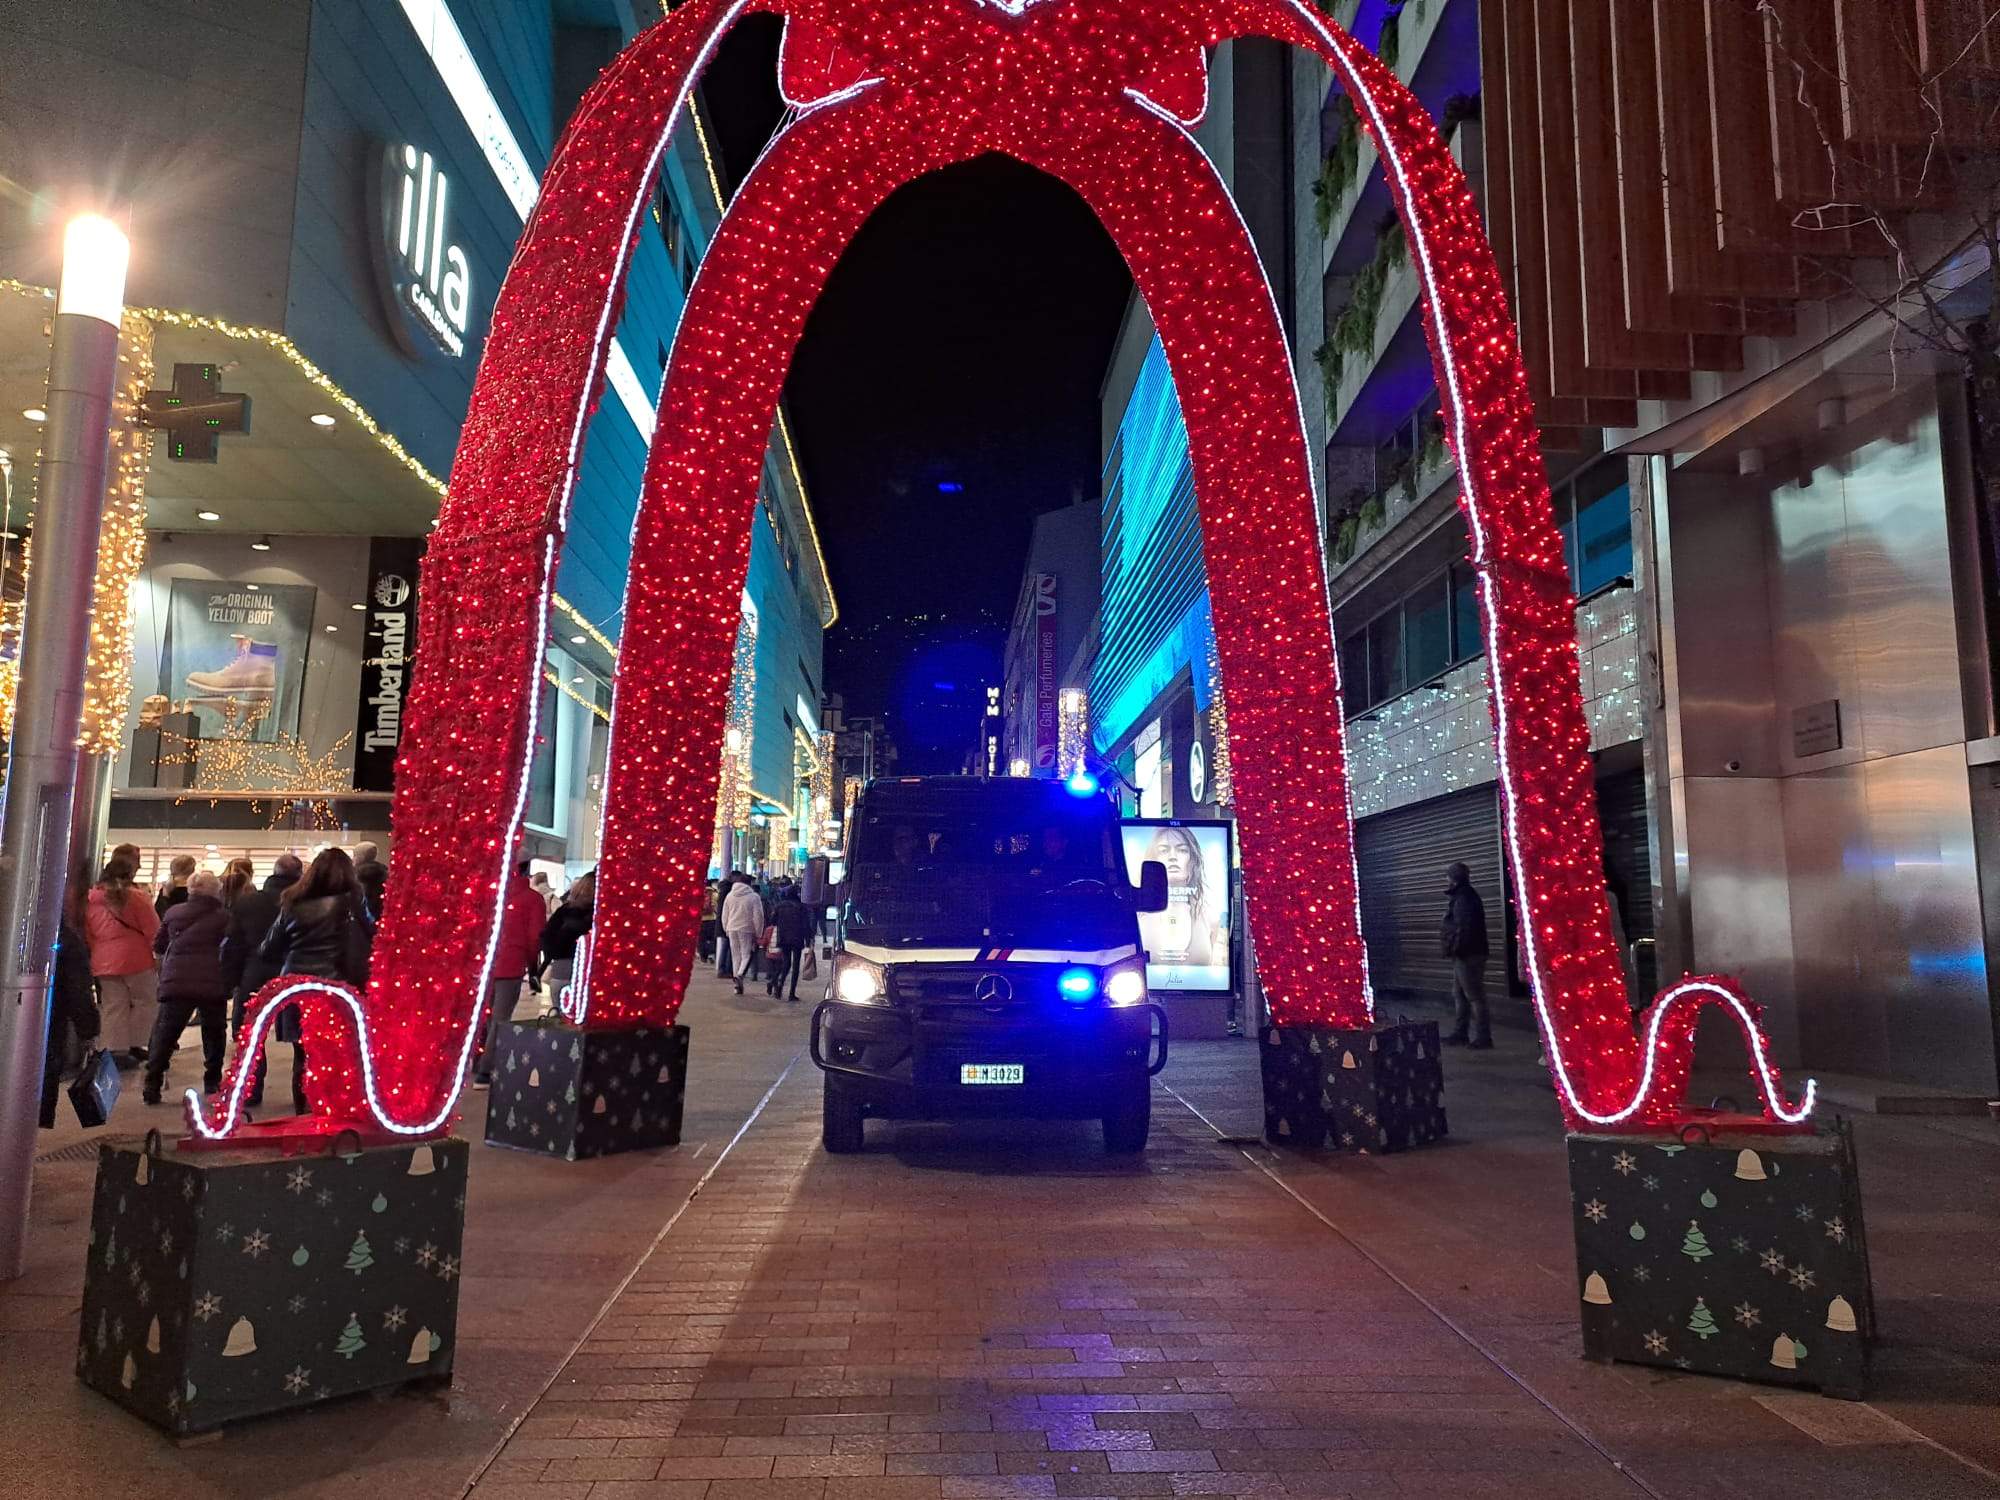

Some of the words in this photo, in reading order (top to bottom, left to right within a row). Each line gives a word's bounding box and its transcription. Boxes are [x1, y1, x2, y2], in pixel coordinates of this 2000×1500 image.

[399, 144, 469, 334] illa
[227, 593, 274, 609] ORIGINAL
[208, 607, 245, 623] YELLOW
[247, 609, 274, 625] BOOT
[364, 612, 407, 753] Timberland
[1167, 886, 1198, 896] BERRY
